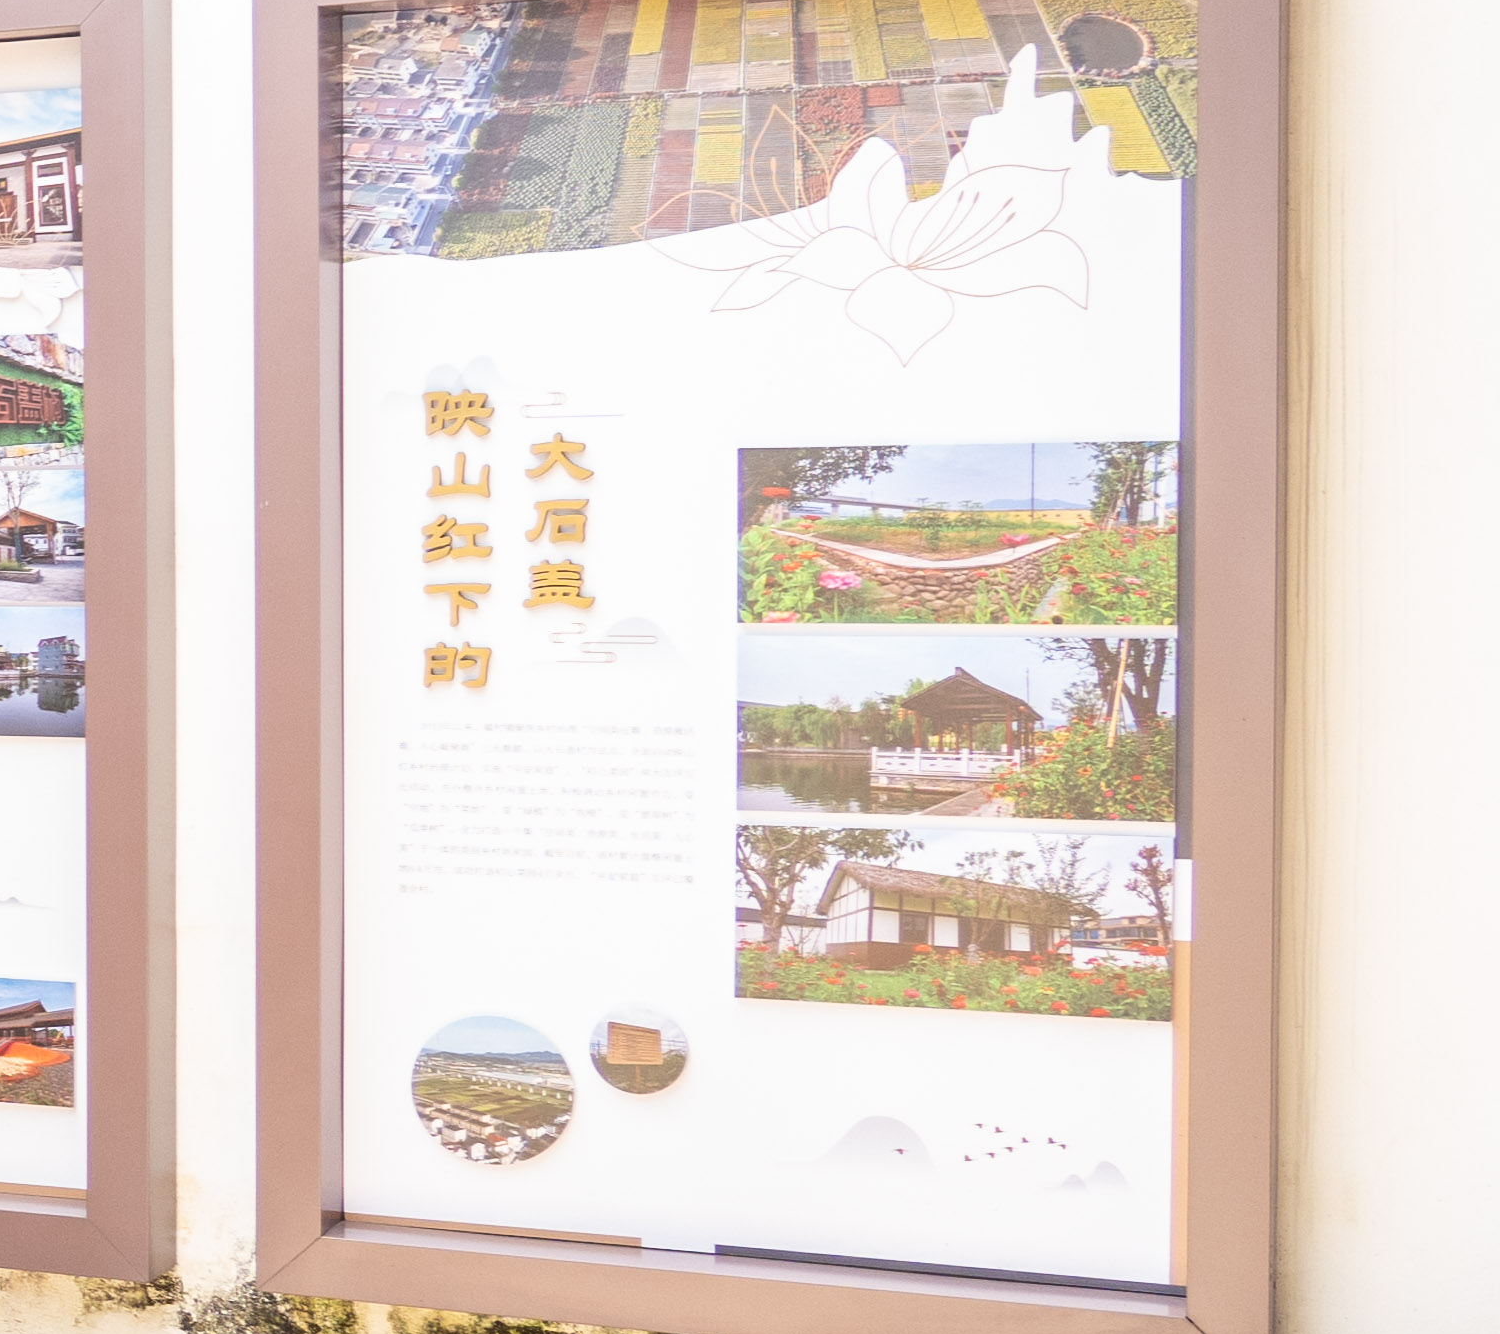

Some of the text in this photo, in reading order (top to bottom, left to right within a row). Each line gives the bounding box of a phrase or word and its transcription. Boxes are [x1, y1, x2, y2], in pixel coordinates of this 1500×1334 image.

[423, 389, 494, 691] 映山红下的
[523, 432, 595, 611] 大石盖
